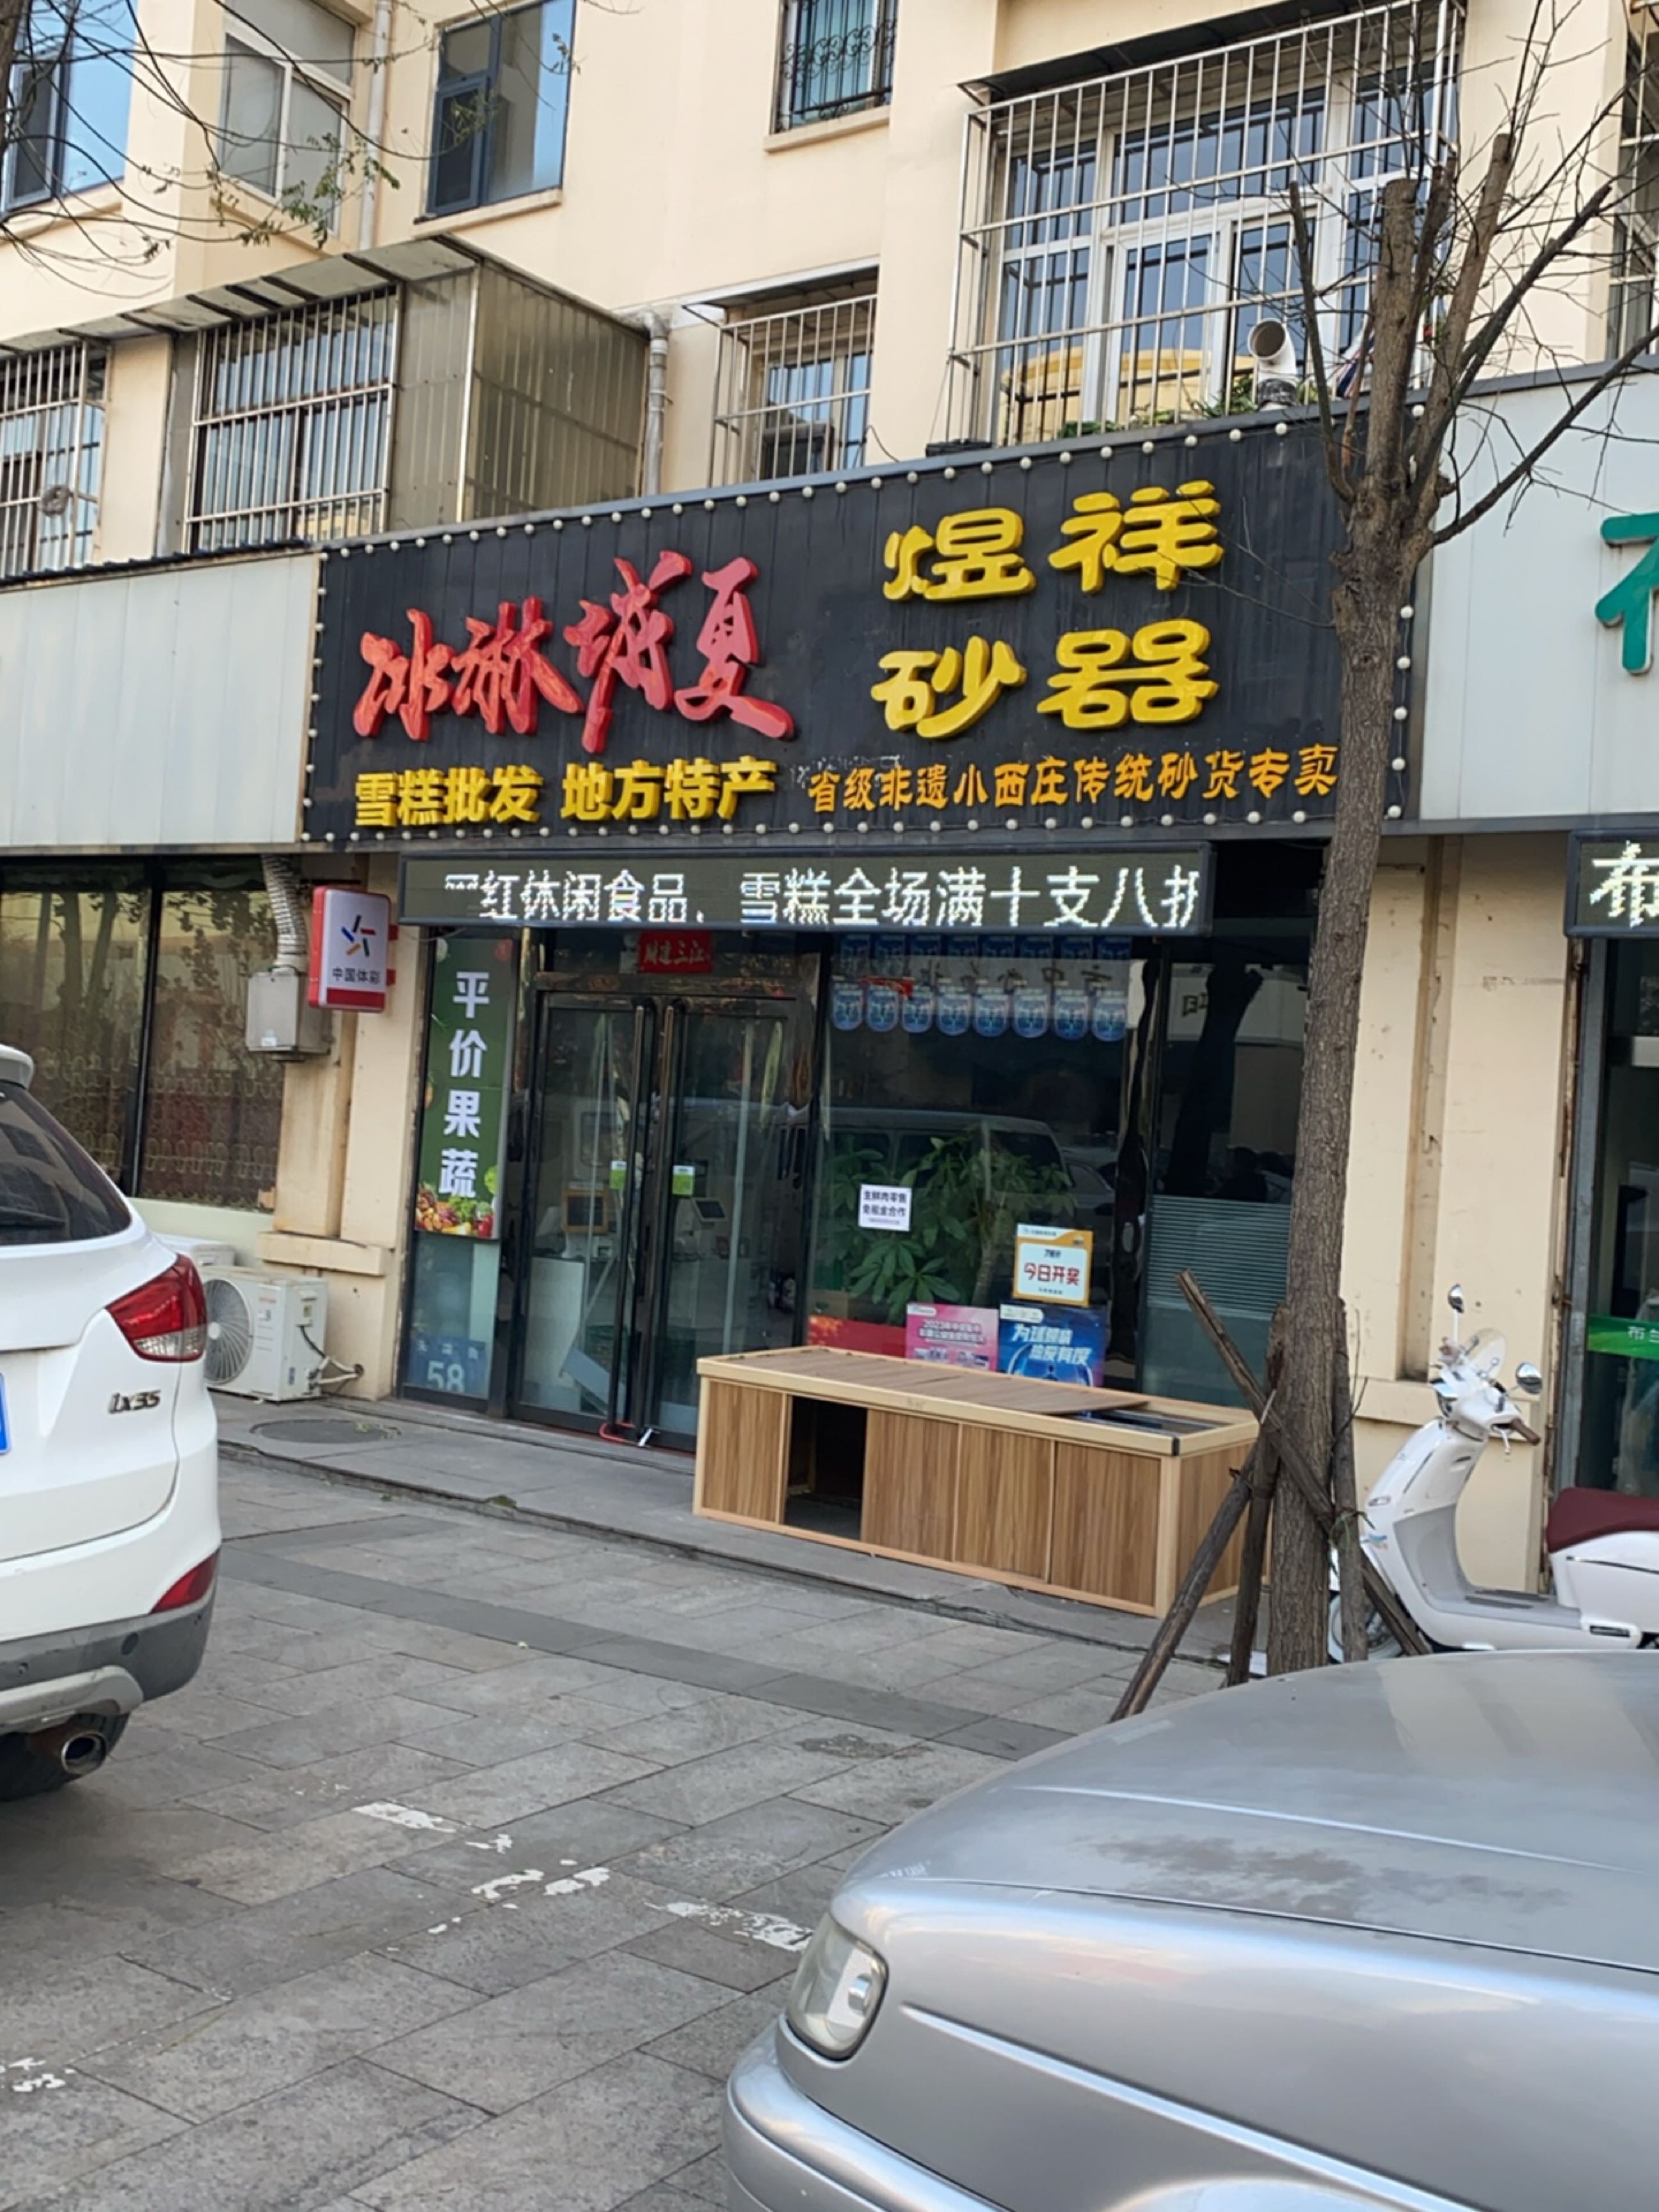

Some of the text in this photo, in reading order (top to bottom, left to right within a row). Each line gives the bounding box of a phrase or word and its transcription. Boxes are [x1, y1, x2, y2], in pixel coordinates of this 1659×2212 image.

[883, 481, 1223, 600] 煜祥
[871, 618, 1219, 739] 砂器
[355, 755, 776, 827] 雪糕批发 地方特产
[807, 743, 1338, 812] 省级非遗小西庄传统砂货专卖
[332, 966, 380, 984] 中国体彩
[438, 972, 489, 1198] 平价果蔬
[1023, 1262, 1080, 1286] 今日开奖
